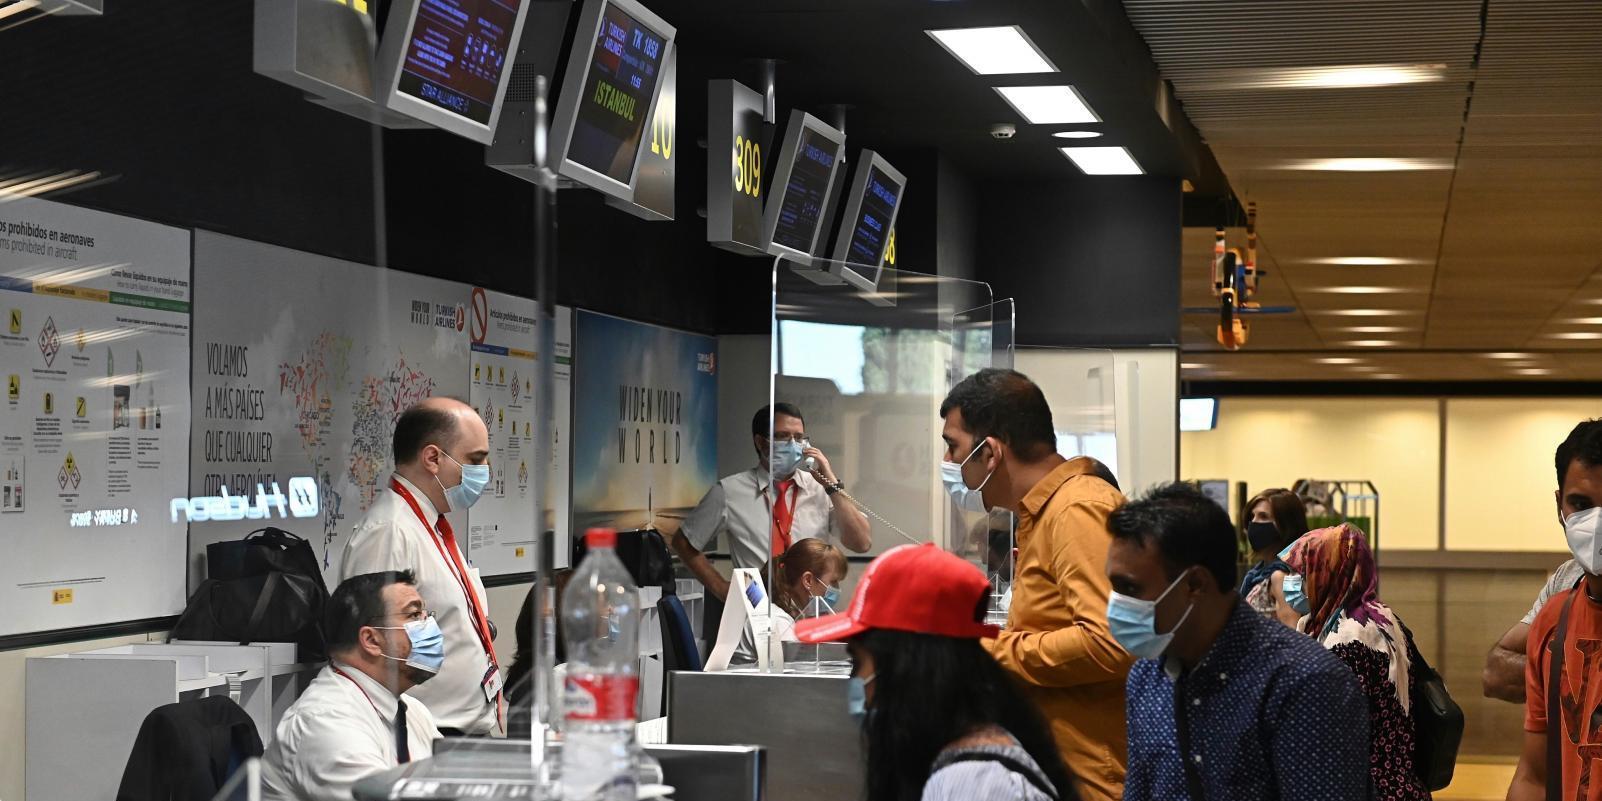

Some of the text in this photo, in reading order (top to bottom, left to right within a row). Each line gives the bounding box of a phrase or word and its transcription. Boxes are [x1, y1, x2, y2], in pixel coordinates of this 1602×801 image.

[632, 28, 644, 50] TK
[594, 79, 636, 121] ISTANBUL
[734, 135, 761, 198] 309
[8, 221, 48, 241] prohibidos
[48, 229, 58, 241] en
[59, 231, 95, 248] aeronaves
[11, 239, 46, 257] prohibited
[434, 316, 456, 329] AIRLINES
[435, 303, 456, 318] TURKISH
[206, 342, 248, 378] VOLAMOS
[205, 382, 265, 421] A MÁS PAÍSES
[618, 384, 682, 425] WIDEN YOUR
[205, 429, 223, 463] QUE
[225, 430, 273, 463] CUALQUIER
[618, 427, 681, 465] WORLD
